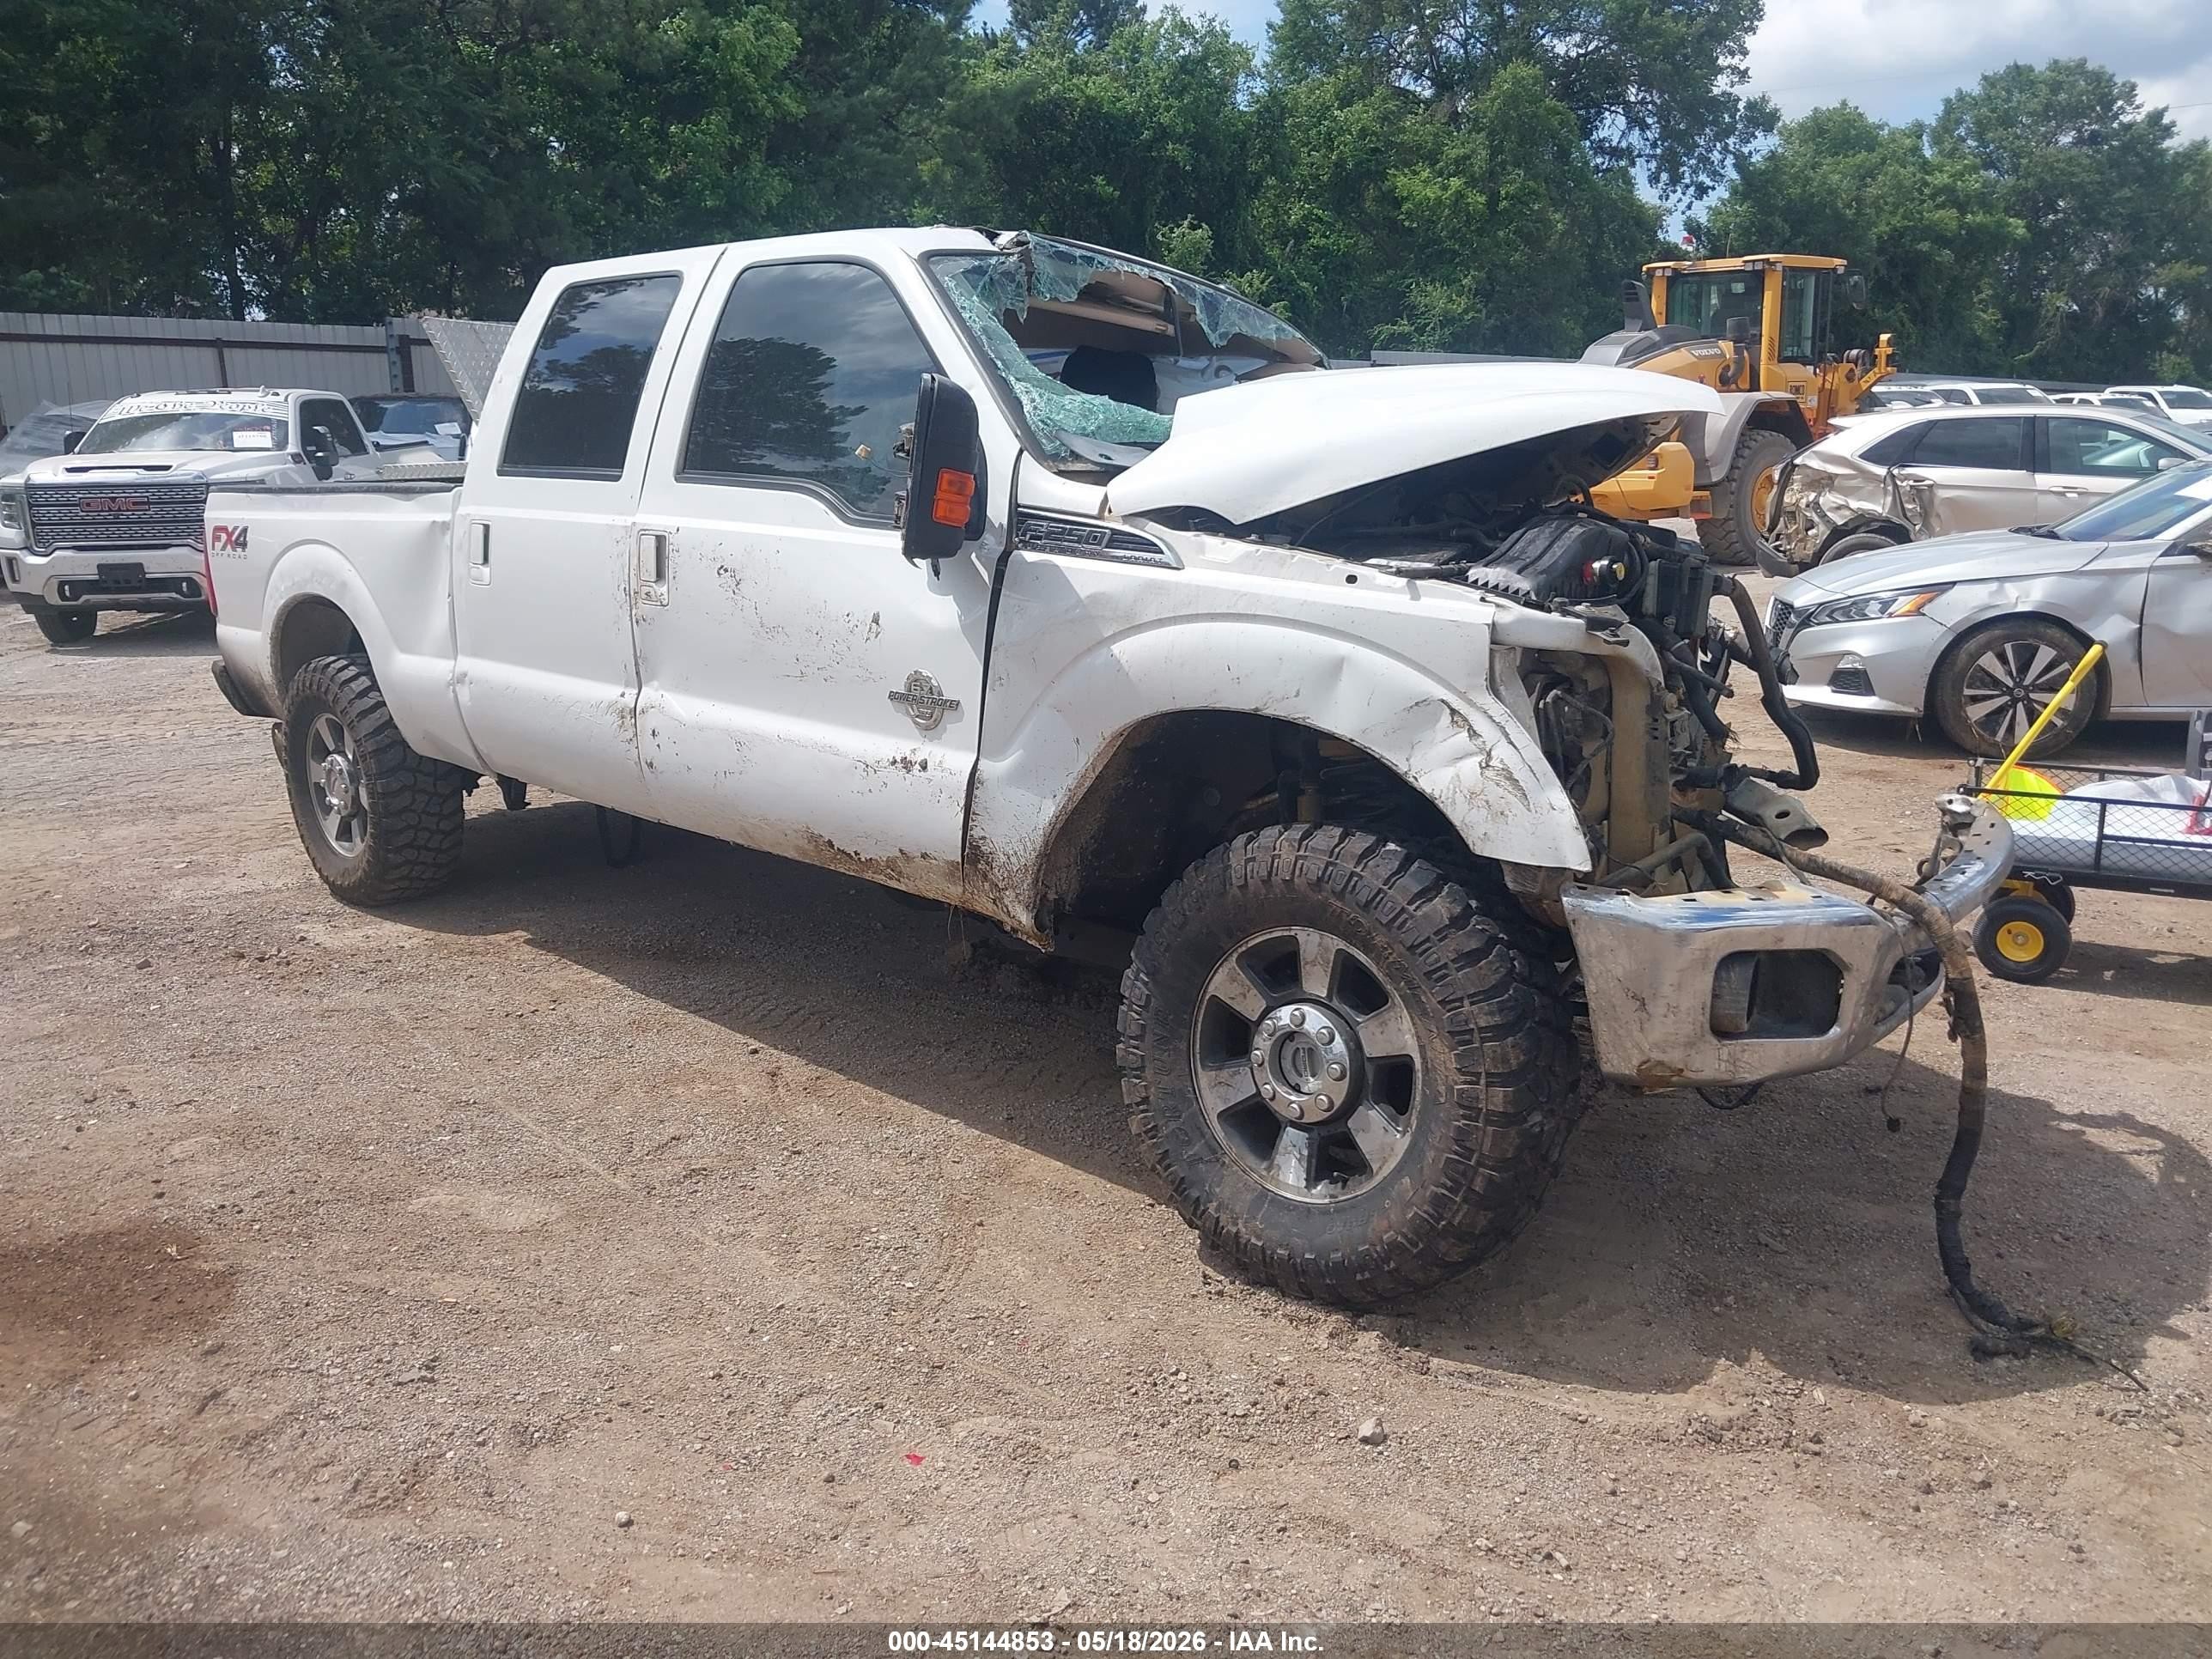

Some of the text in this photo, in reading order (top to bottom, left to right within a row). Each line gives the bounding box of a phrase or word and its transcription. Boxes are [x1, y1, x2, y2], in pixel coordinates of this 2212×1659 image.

[1691, 348, 1722, 356] VOLVO
[81, 498, 149, 511] GMC
[211, 525, 249, 552] FX4
[888, 690, 957, 709] POWER STROKE
